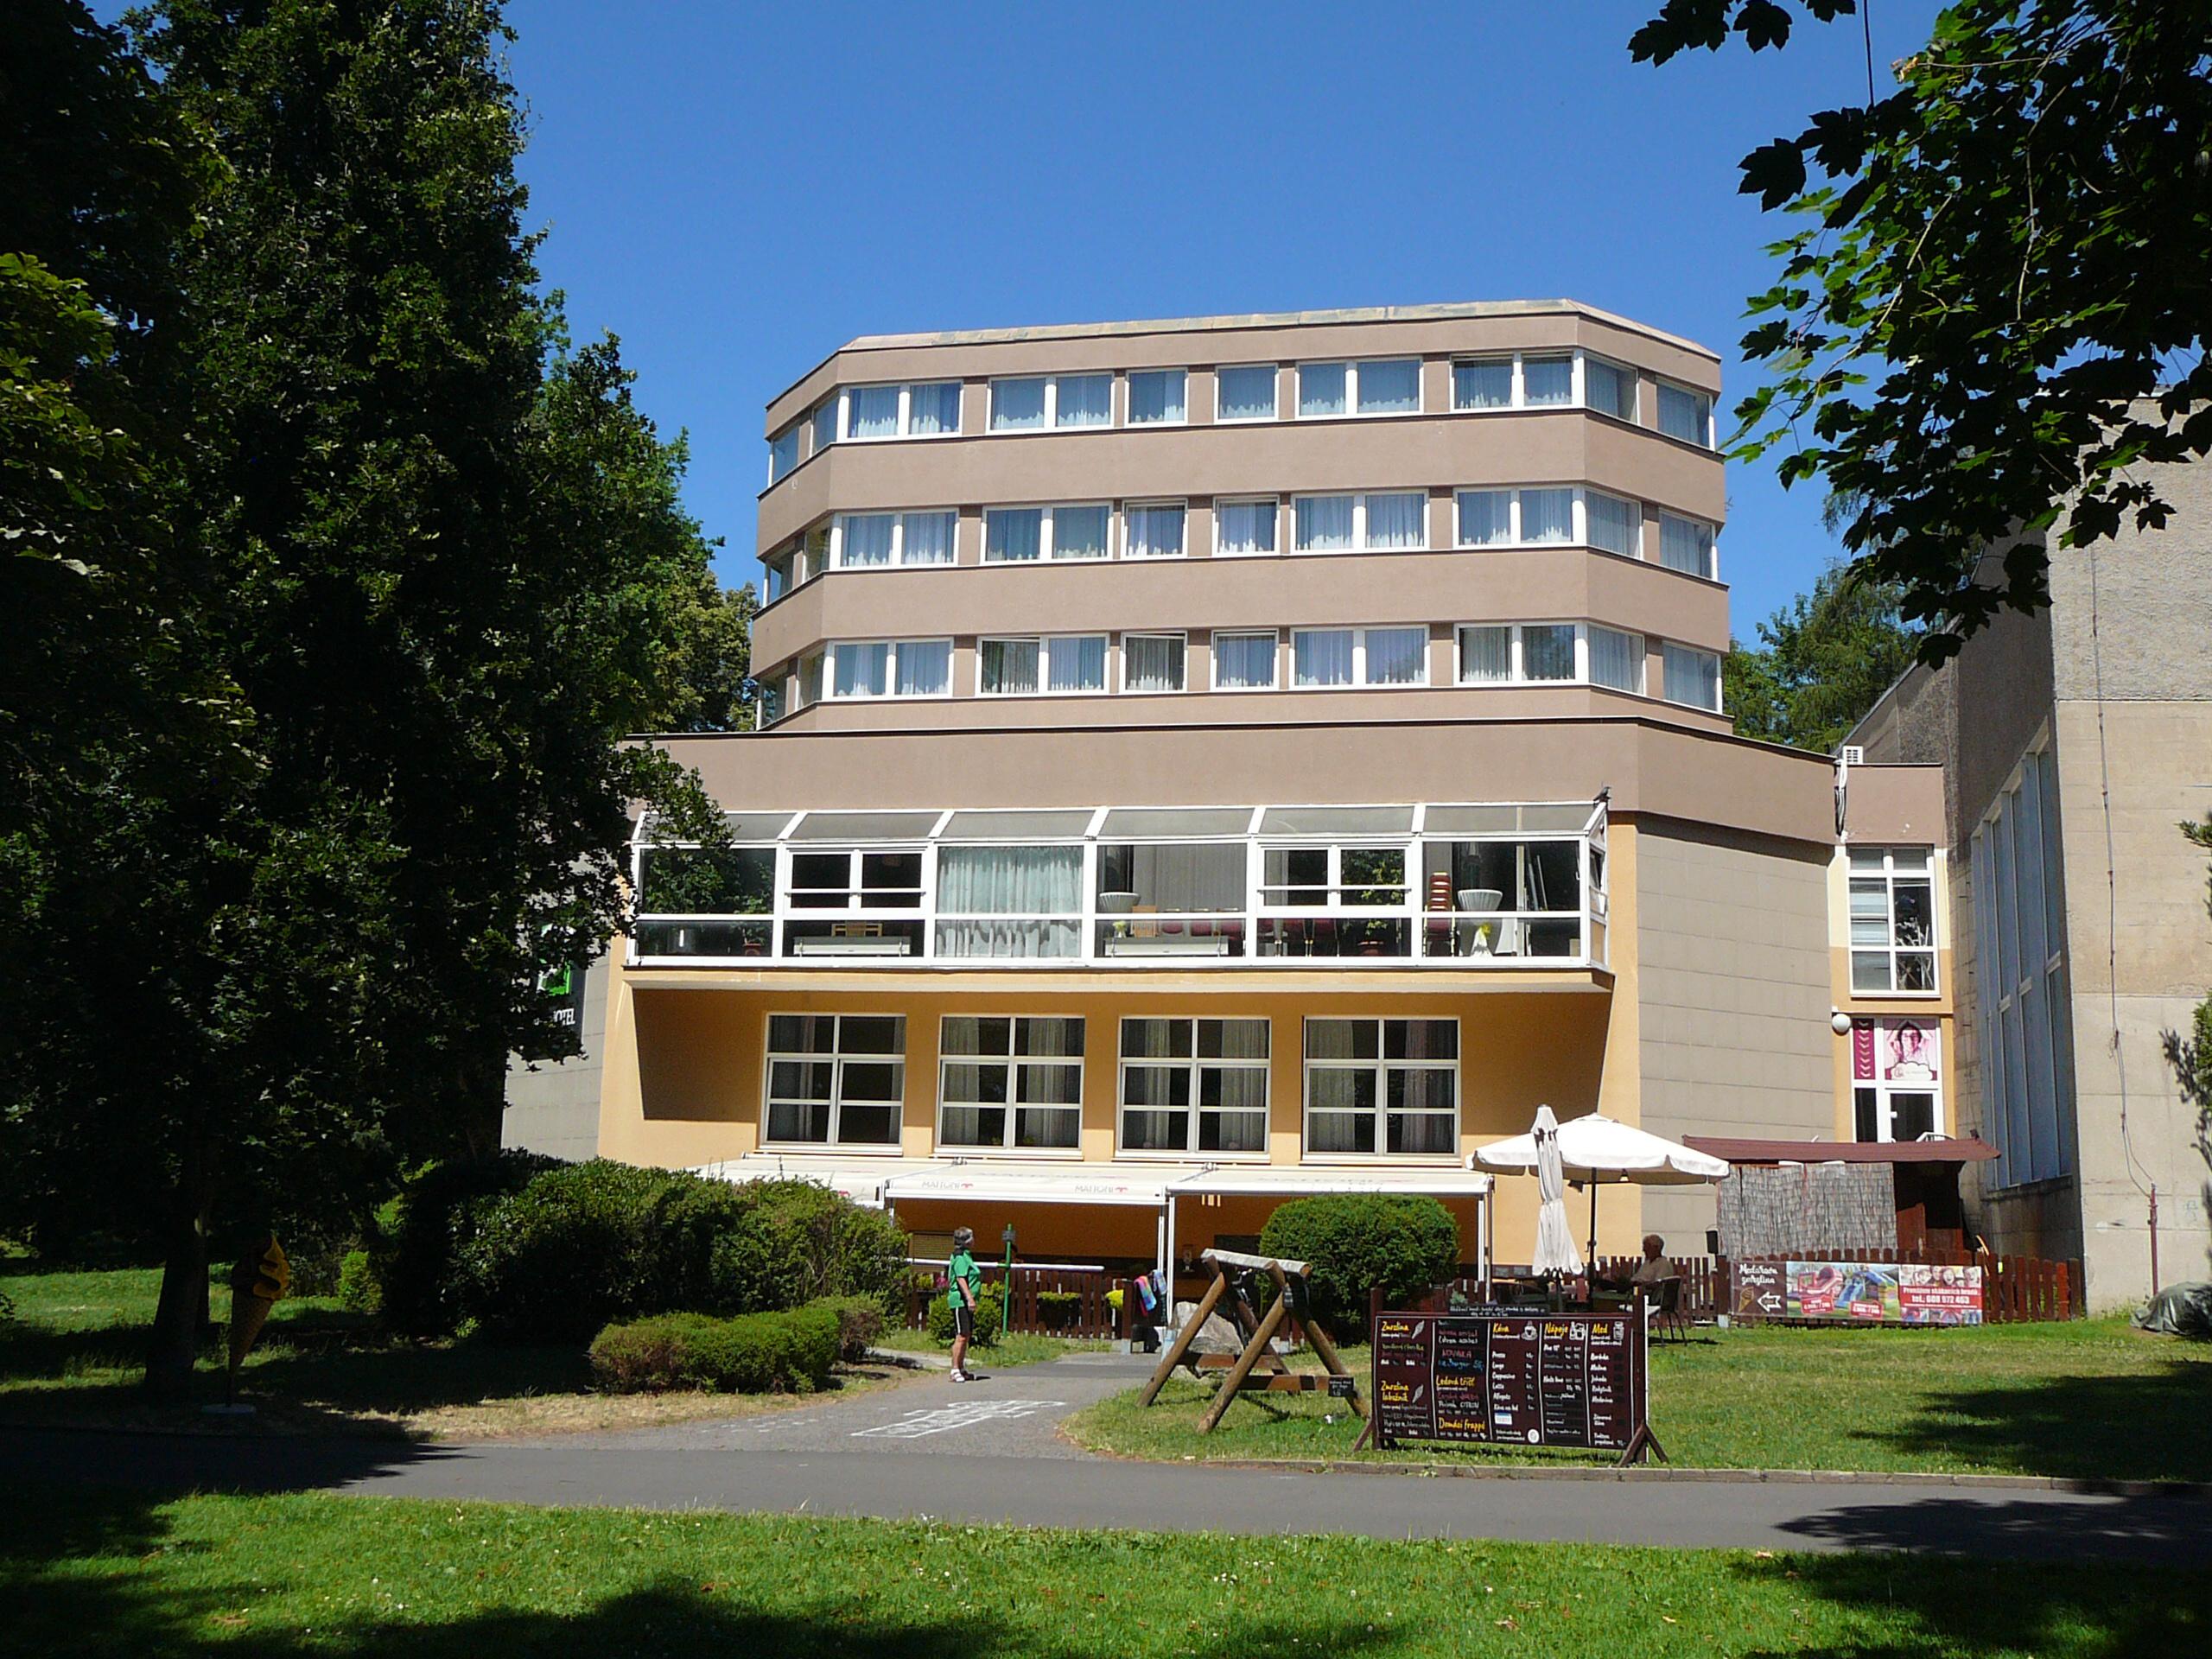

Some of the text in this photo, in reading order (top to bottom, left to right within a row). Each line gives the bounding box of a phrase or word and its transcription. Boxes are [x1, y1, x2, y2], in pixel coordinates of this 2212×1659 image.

[554, 1008, 575, 1026] OTEL
[1382, 1321, 1409, 1332] Zmrzlina
[1493, 1322, 1510, 1332] Káva
[1545, 1322, 1568, 1338] Nápoje
[1592, 1323, 1608, 1334] Med
[1381, 1380, 1408, 1391] Zmrzlina
[1436, 1375, 1459, 1387] Ledová
[1439, 1417, 1463, 1429] Domácí
